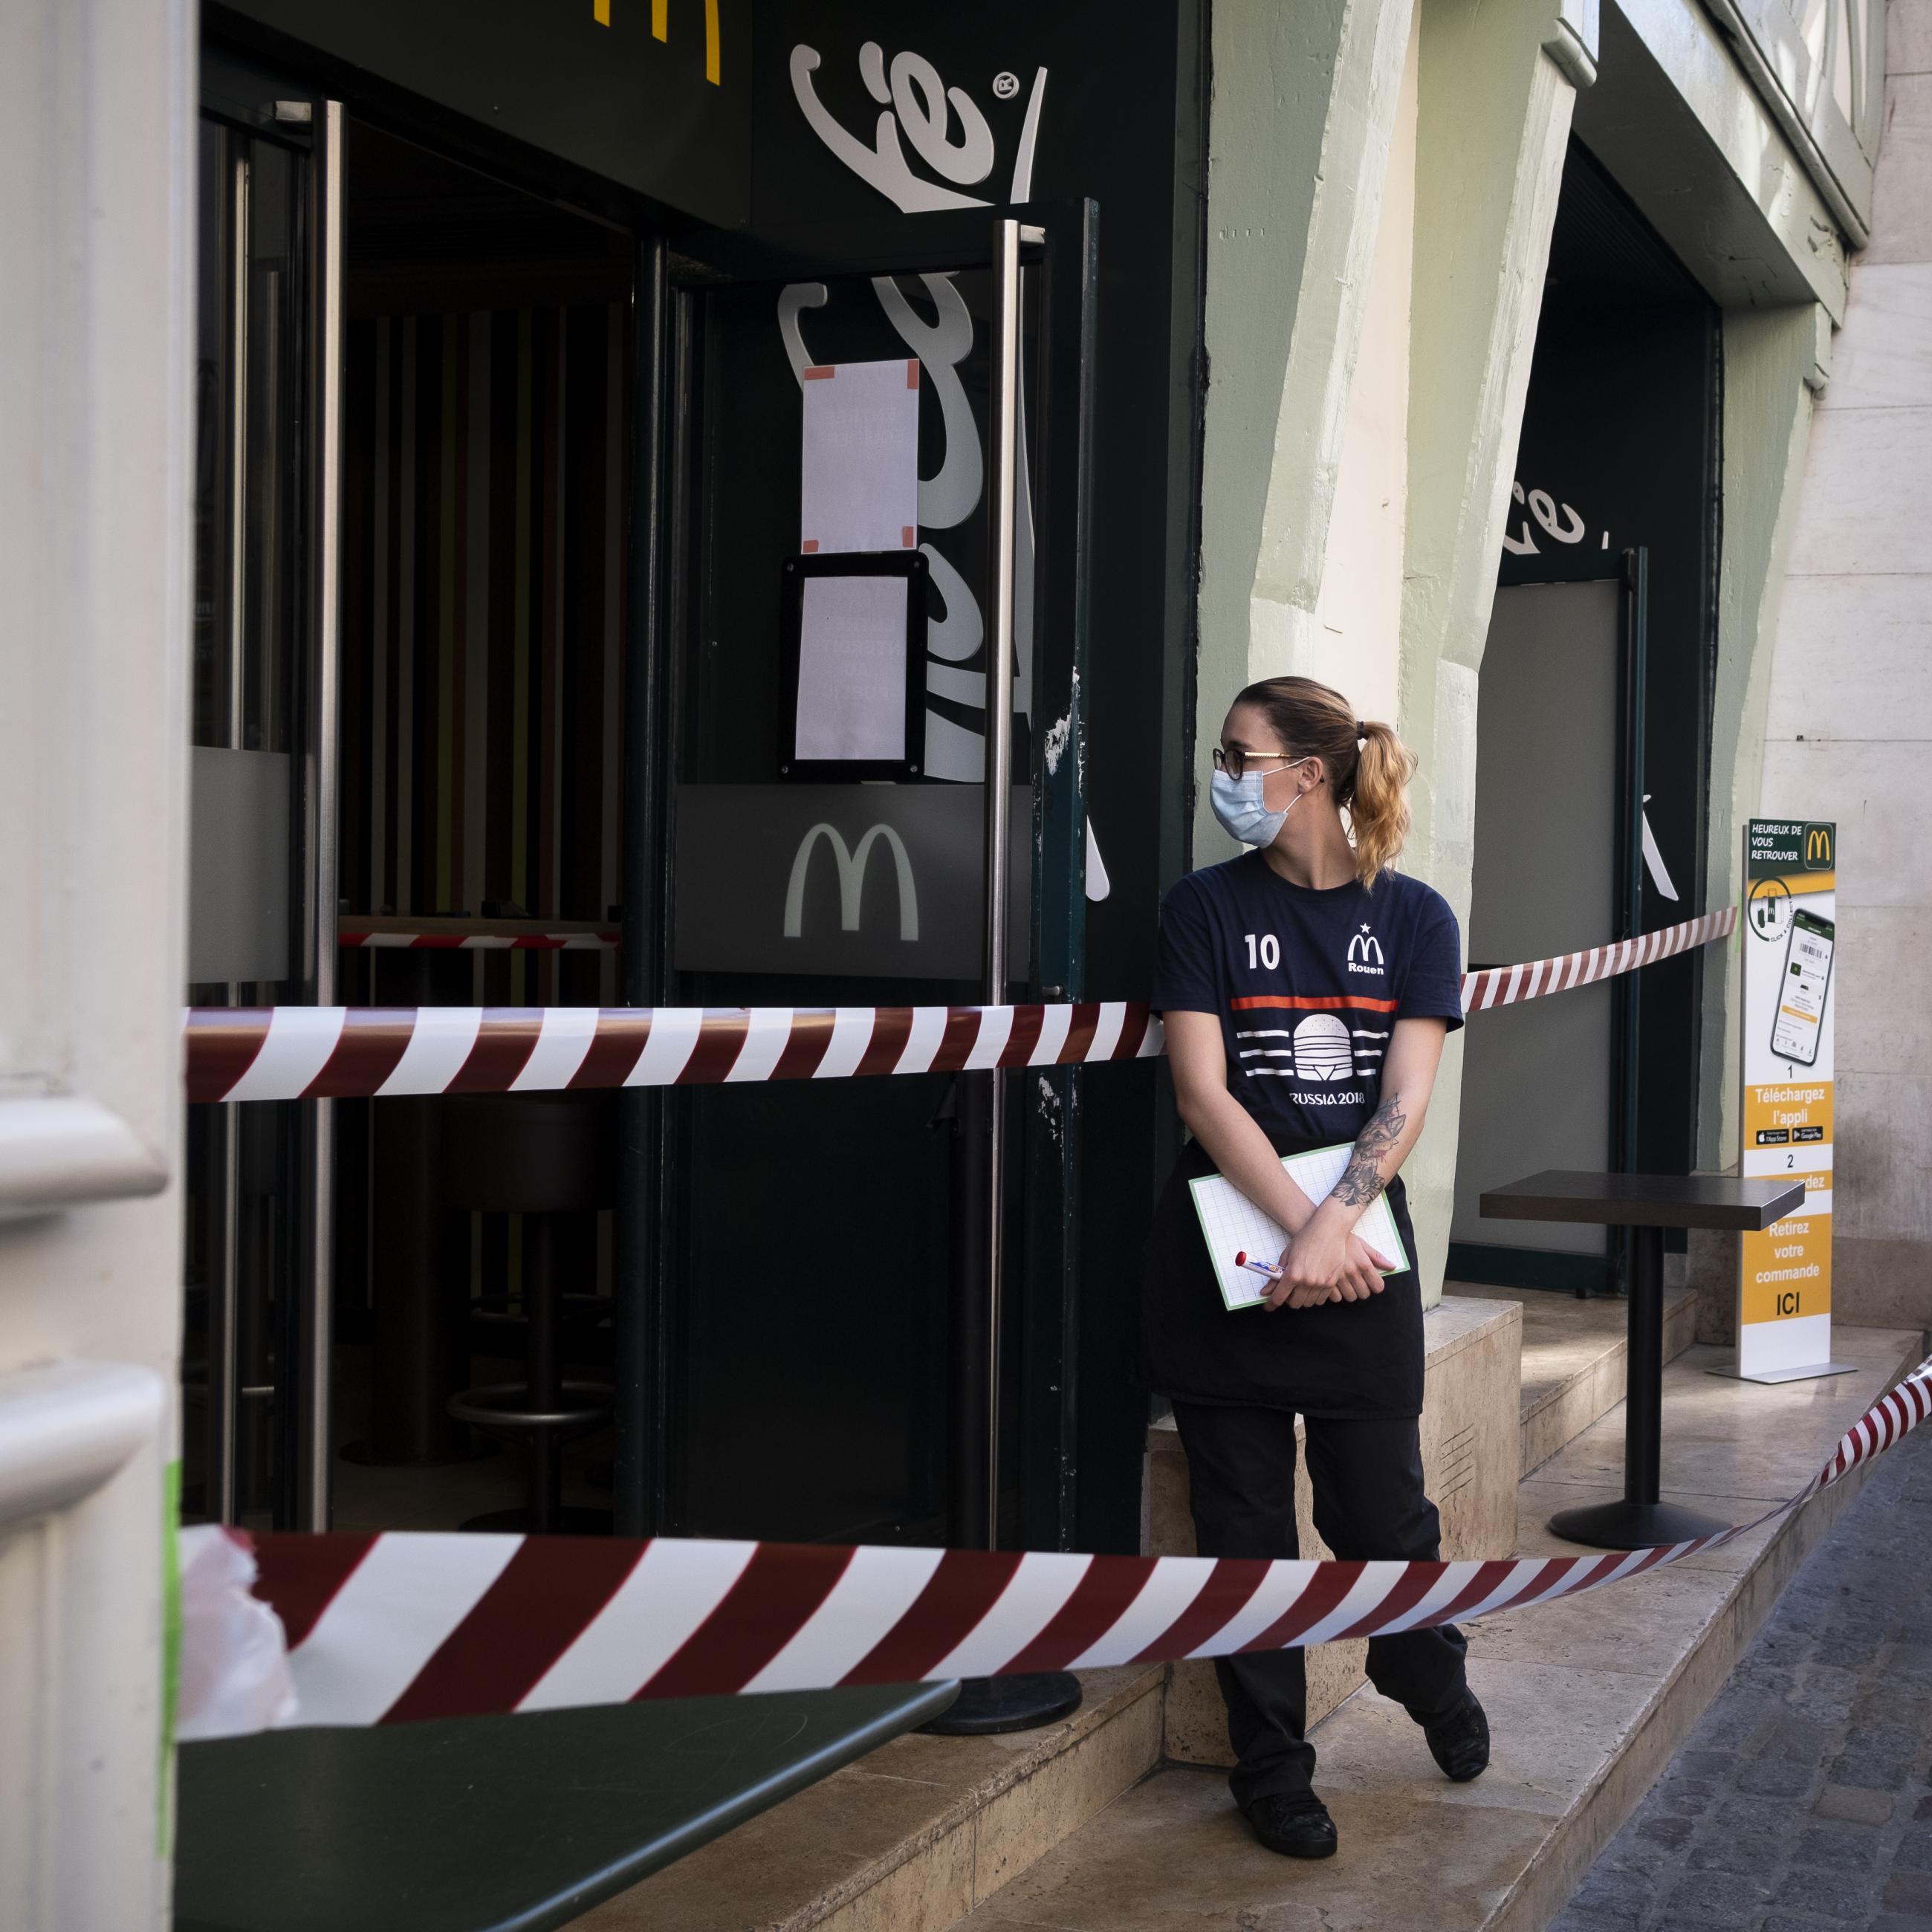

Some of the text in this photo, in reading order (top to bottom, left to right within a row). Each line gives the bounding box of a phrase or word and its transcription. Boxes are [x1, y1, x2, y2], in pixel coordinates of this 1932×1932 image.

[1752, 824, 1802, 835] HEUREUX DE
[1751, 837, 1774, 847] VOUS
[1751, 850, 1798, 860] RETROUVER
[1244, 934, 1280, 970] 10
[1348, 962, 1384, 975] Rouen
[1788, 1065, 1793, 1079] 1
[1289, 1092, 1365, 1105] RUSSIA 2018
[1755, 1087, 1825, 1104] Téléchargez
[1773, 1109, 1808, 1127] l'appli
[1787, 1154, 1794, 1168] 2
[1769, 1221, 1809, 1236] Retirez
[1774, 1244, 1804, 1259] votre
[1756, 1263, 1820, 1283] commande
[1777, 1291, 1800, 1316] ICI
